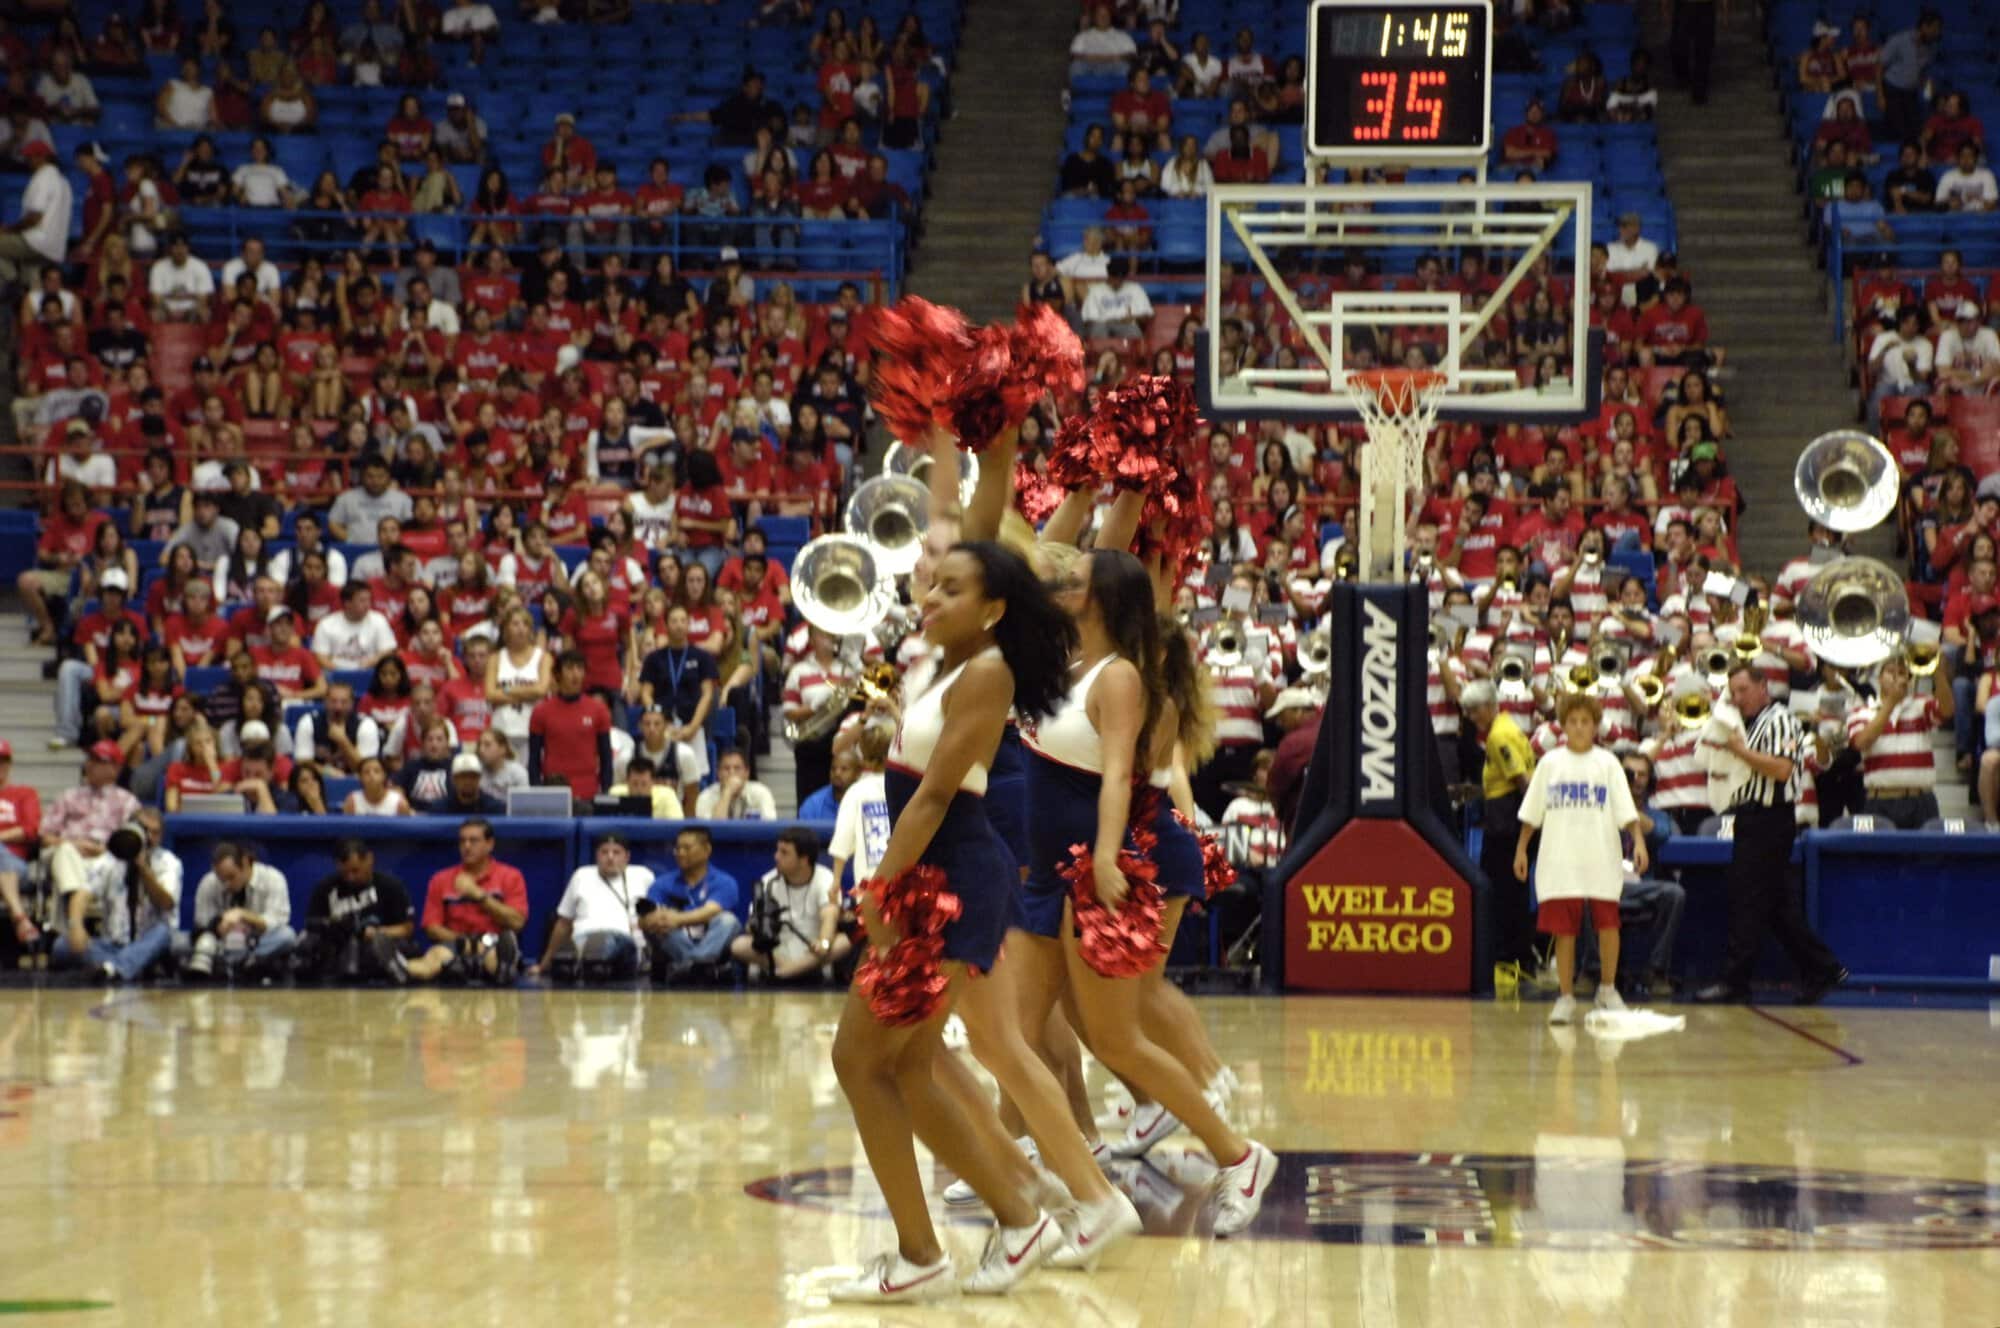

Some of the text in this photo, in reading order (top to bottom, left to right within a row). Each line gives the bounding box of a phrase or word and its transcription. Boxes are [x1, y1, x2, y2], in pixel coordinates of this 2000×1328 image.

[1380, 13, 1469, 57] 1:45
[1353, 71, 1447, 140] 35
[1360, 598, 1399, 803] ARIZONA
[1302, 885, 1455, 917] WELLS
[1307, 921, 1452, 953] FARGO
